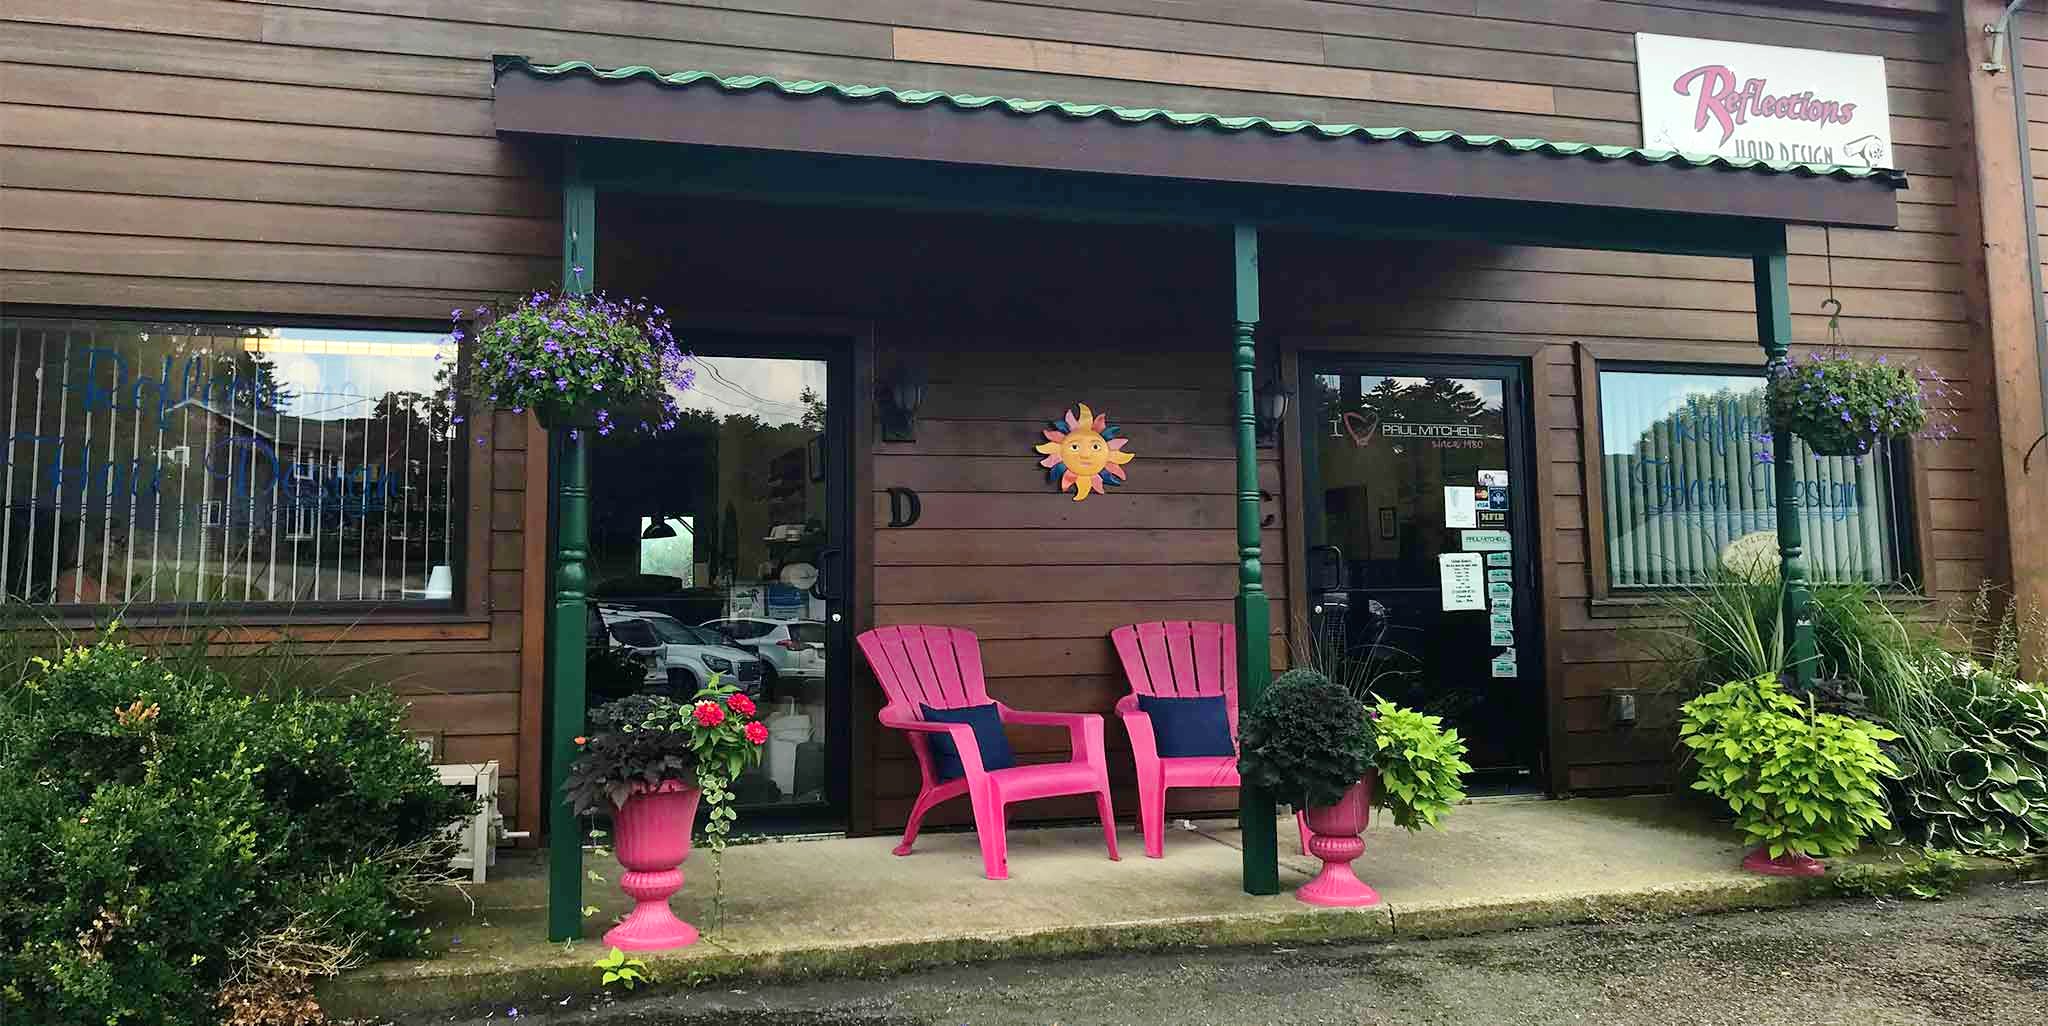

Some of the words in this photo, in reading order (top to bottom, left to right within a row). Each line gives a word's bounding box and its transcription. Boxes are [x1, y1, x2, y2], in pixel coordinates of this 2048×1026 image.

[1672, 64, 1858, 148] Reflections
[1382, 424, 1416, 436] PAUL
[1418, 425, 1483, 438] MITCHELL
[1431, 440, 1460, 449] since
[1462, 440, 1483, 449] 1980
[887, 488, 921, 528] D
